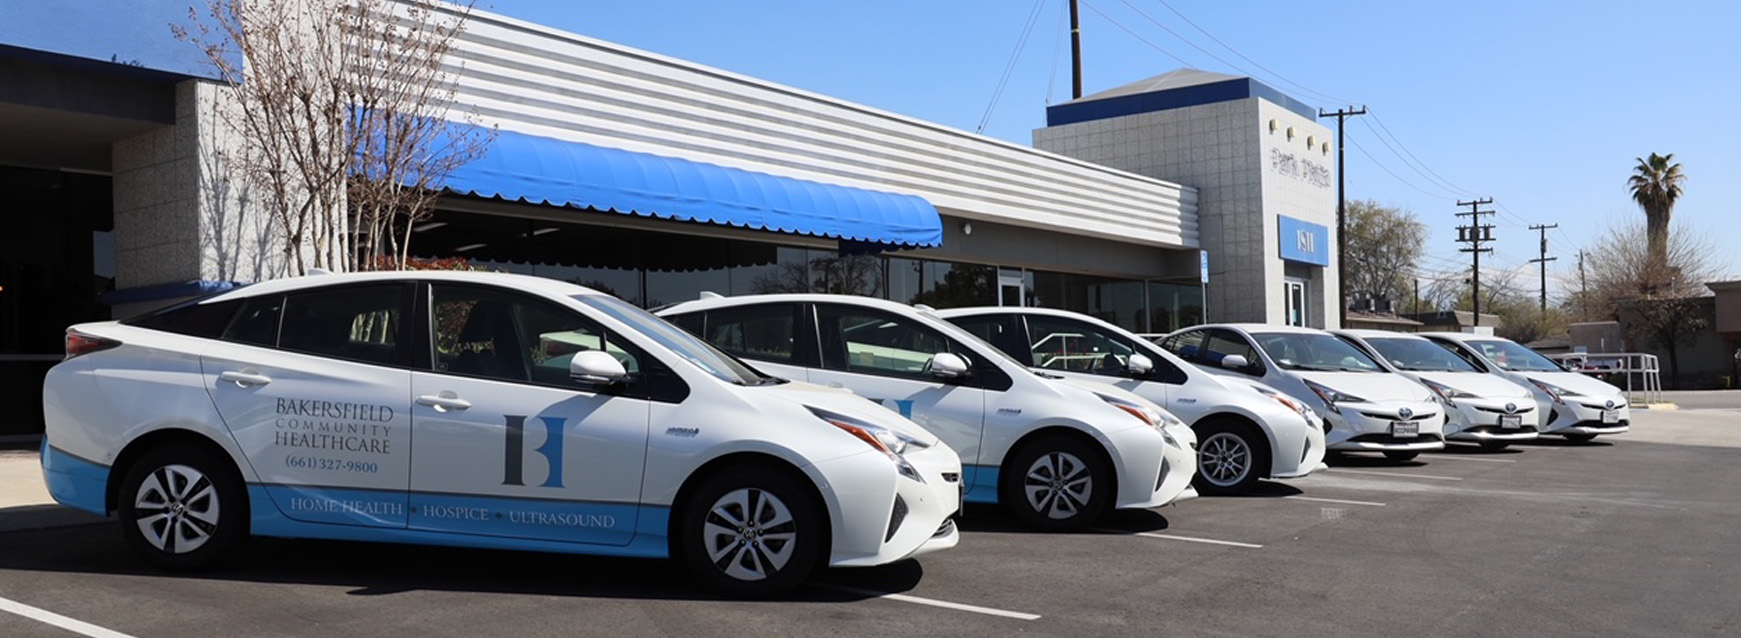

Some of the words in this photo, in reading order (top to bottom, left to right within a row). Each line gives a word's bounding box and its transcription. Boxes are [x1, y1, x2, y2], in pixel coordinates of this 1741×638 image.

[275, 397, 394, 423] BAKERSFIELD
[275, 418, 392, 437] COMMUNITY
[274, 431, 391, 454] HEALTHCARE
[291, 497, 338, 512] HOME
[342, 500, 402, 515] HEALTH
[423, 505, 489, 521] HOSPICE
[509, 511, 615, 528] ULTRASOUND
